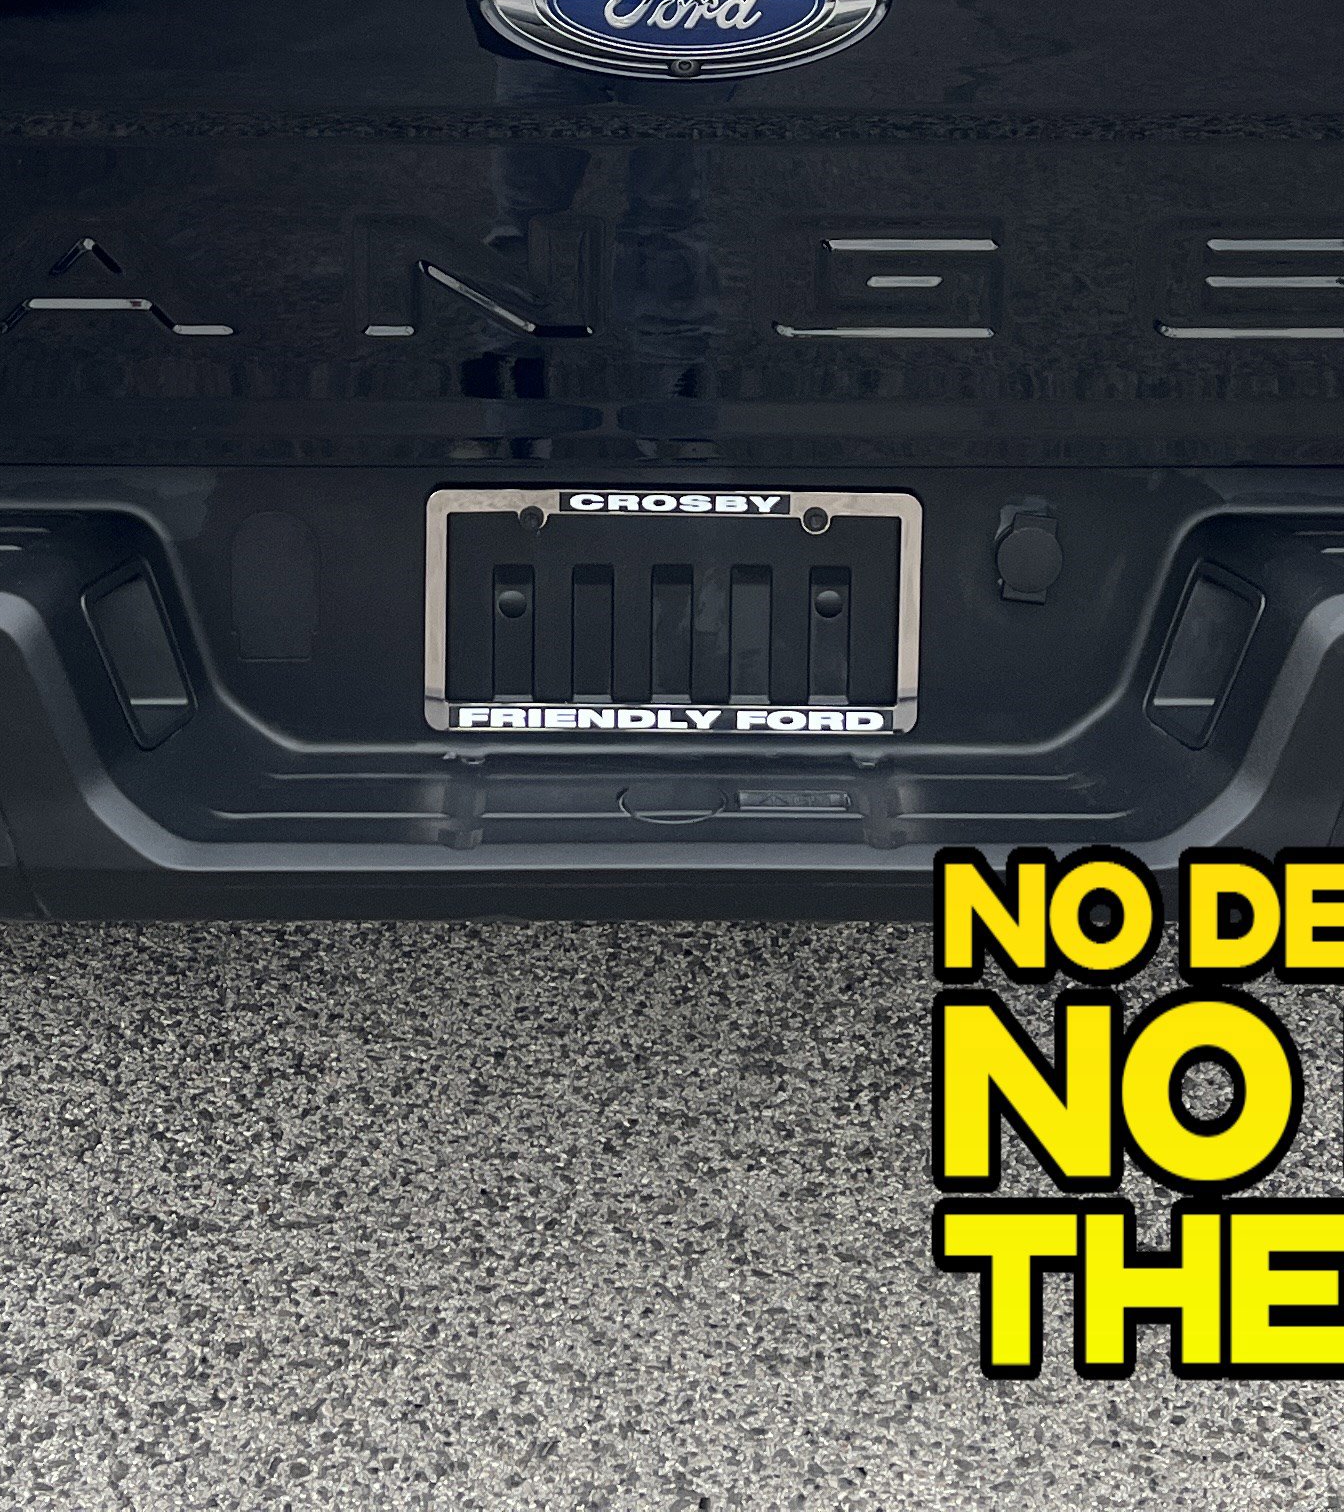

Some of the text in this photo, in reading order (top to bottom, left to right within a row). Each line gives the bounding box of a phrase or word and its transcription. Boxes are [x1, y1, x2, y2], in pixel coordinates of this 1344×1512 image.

[569, 493, 782, 513] CROSBY
[458, 707, 884, 731] FRIENDLY FORD
